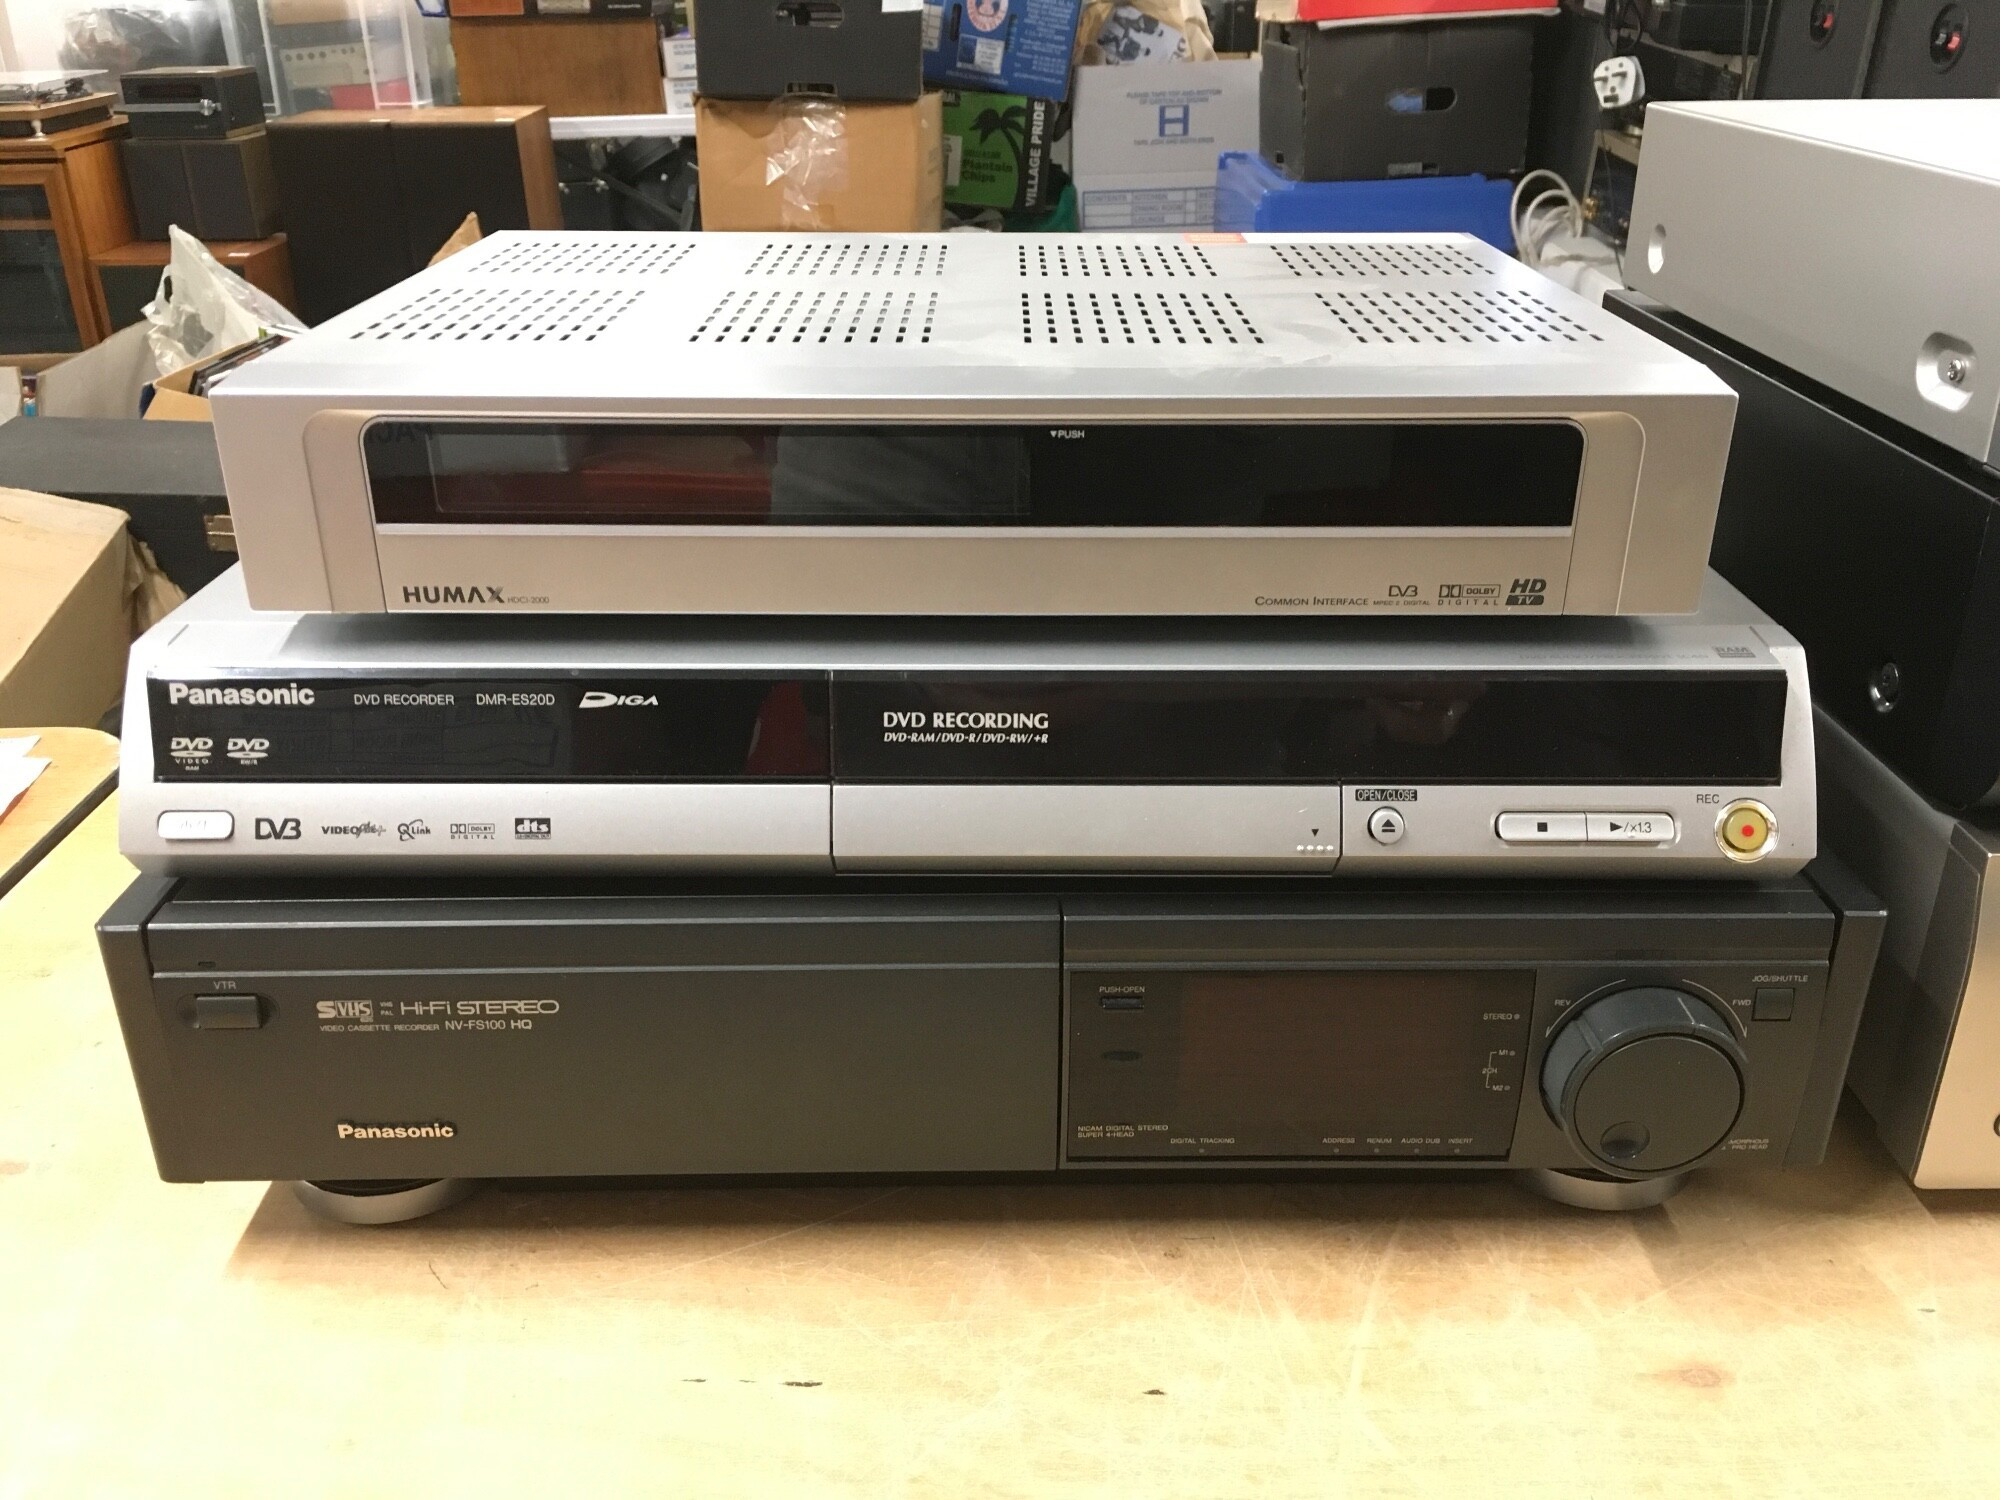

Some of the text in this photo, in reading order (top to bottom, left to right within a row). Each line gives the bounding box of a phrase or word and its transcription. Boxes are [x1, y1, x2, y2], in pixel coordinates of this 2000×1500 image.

[1025, 101, 1045, 207] VILLAGE PRIDE
[961, 170, 996, 182] Chips
[1057, 430, 1085, 438] PUSH
[1466, 587, 1496, 595] DOLBY
[1510, 578, 1548, 594] HD
[402, 586, 550, 604] HUMAX HDCI-2000
[1516, 595, 1534, 605] TV
[1438, 598, 1499, 606] DIGITAL
[168, 682, 316, 706] Panasonic
[354, 694, 455, 706] DVD RECORDER
[476, 693, 556, 706] DMR-ES20D
[579, 691, 659, 708] DIGA
[883, 711, 1049, 729] DVD RECORDING
[171, 737, 214, 751] DVD
[227, 738, 270, 752] DVD
[1357, 789, 1416, 801] OPEN/CLOSE
[1696, 793, 1720, 804] REC
[516, 819, 550, 834] dts
[1752, 974, 1809, 983] JOG/SHUTTLE
[213, 980, 237, 990] VTR
[1099, 985, 1146, 993] PUSH-OPEN
[400, 999, 560, 1015] Hi-Fi STEREO
[1555, 999, 1571, 1007] REV
[1732, 999, 1752, 1007] FWD
[1483, 1012, 1513, 1020] STEREO
[320, 1019, 533, 1032] VIDEO CASSETTE RECORDER NV-FS100 HQ
[337, 1123, 454, 1139] Panasonic
